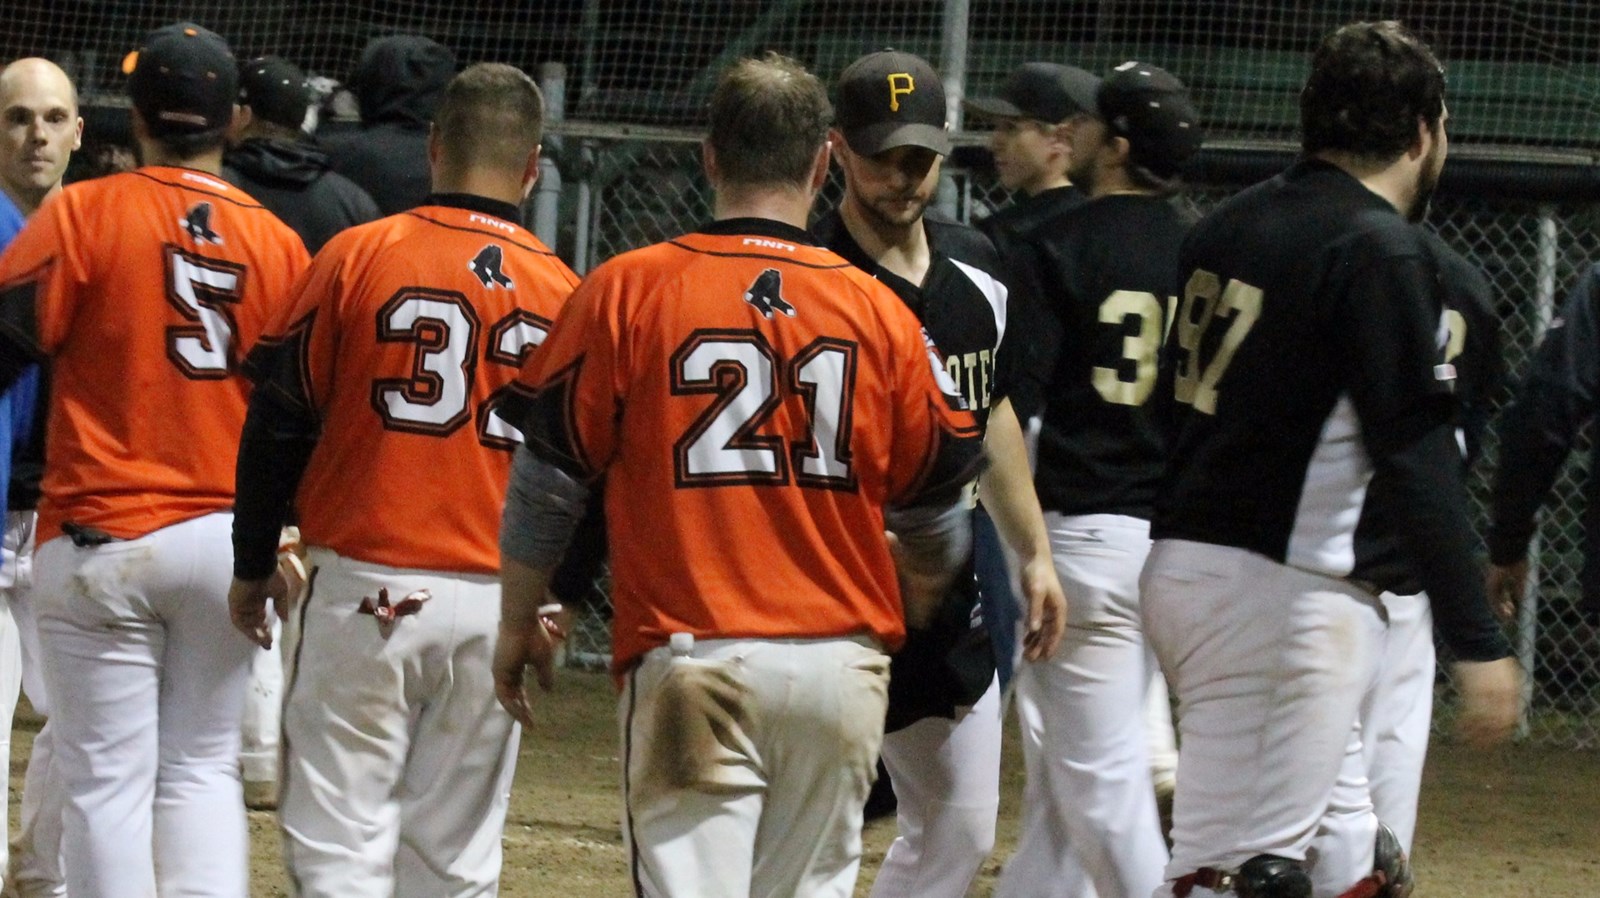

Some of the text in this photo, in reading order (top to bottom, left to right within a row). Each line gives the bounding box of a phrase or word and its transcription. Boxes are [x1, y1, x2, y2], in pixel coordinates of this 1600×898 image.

[887, 72, 915, 112] P
[163, 241, 247, 380] 5
[1090, 289, 1178, 406] 3
[1174, 267, 1263, 416] 97
[669, 328, 859, 495] 21
[946, 349, 991, 411] OTE
